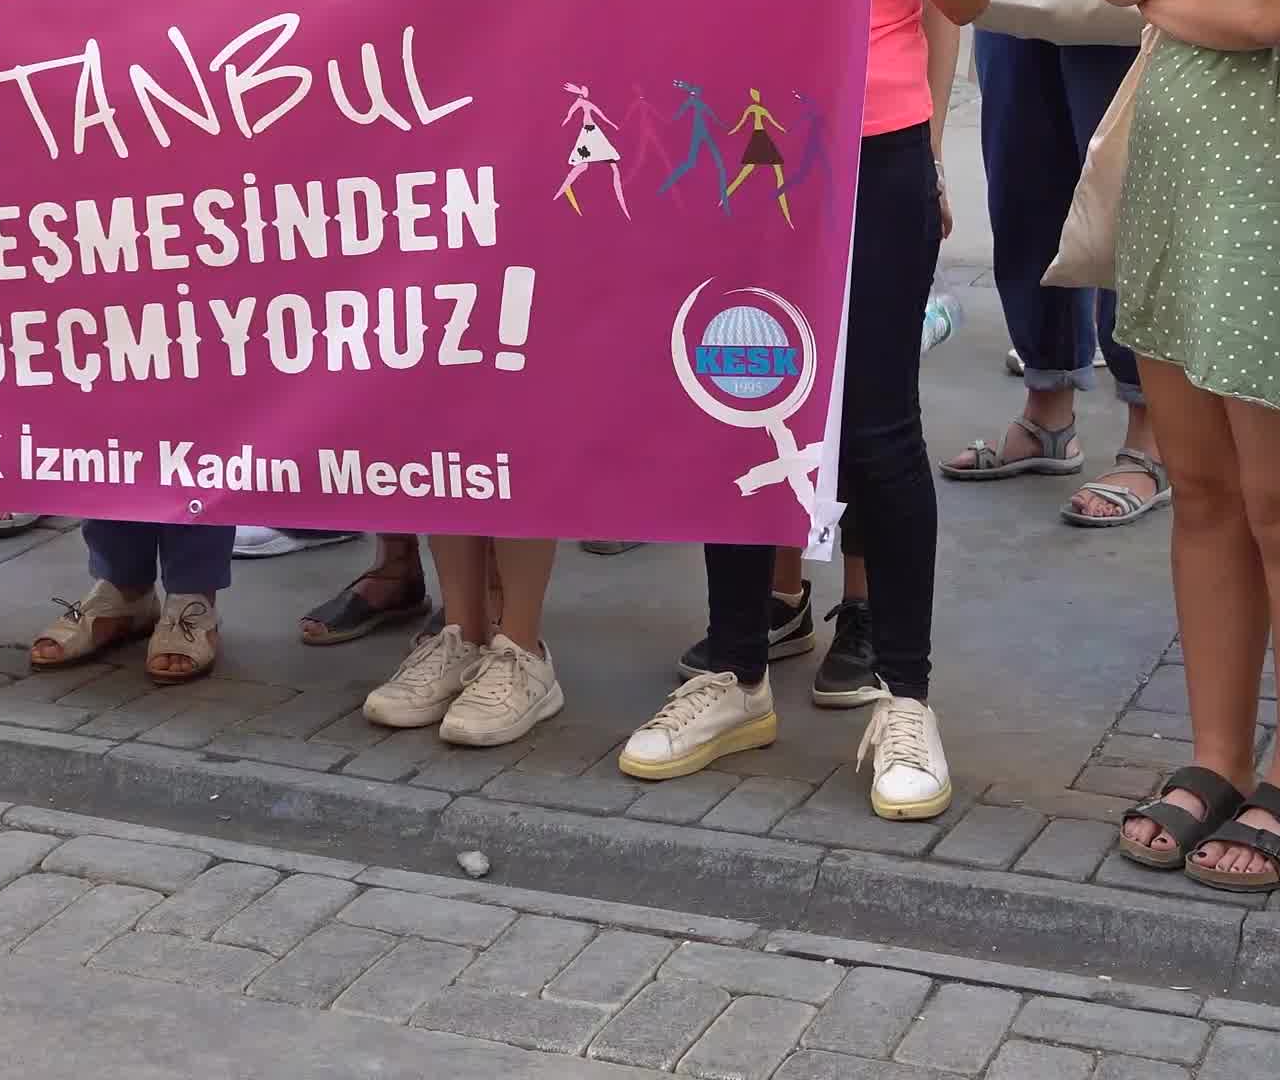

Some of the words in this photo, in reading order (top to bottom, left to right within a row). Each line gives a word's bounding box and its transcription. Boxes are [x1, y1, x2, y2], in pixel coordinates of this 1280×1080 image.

[695, 346, 800, 376] KESK
[19, 422, 143, 485] İzmir
[158, 440, 301, 494] Kadın
[318, 448, 513, 500] Meclisi
